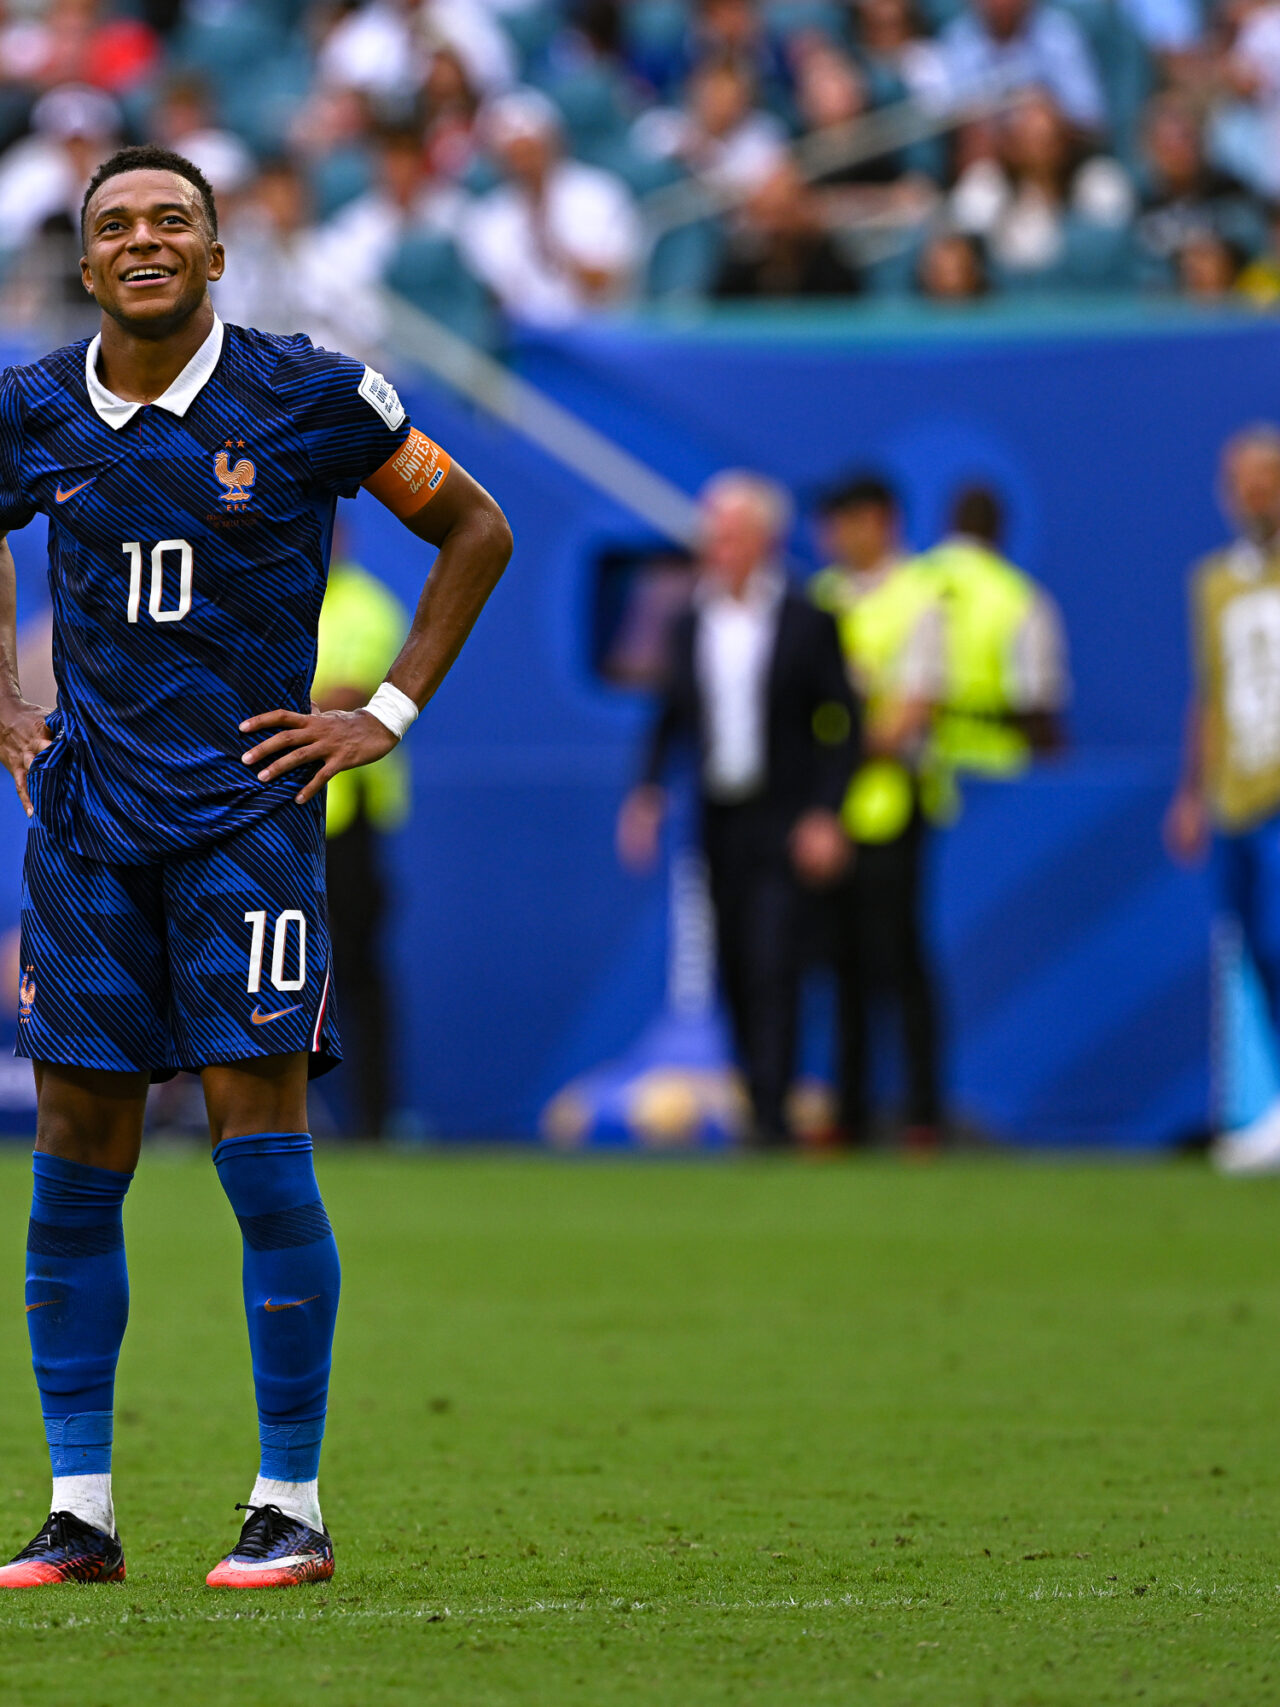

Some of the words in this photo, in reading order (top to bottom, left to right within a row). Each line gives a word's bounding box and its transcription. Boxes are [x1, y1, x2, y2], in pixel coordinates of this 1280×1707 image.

[392, 432, 418, 472] FOOTBALL
[399, 436, 430, 482] UNITES
[421, 445, 441, 477] World
[429, 469, 443, 488] FIFA
[226, 503, 247, 511] FFF
[122, 539, 193, 623] 10
[244, 909, 307, 993] 10
